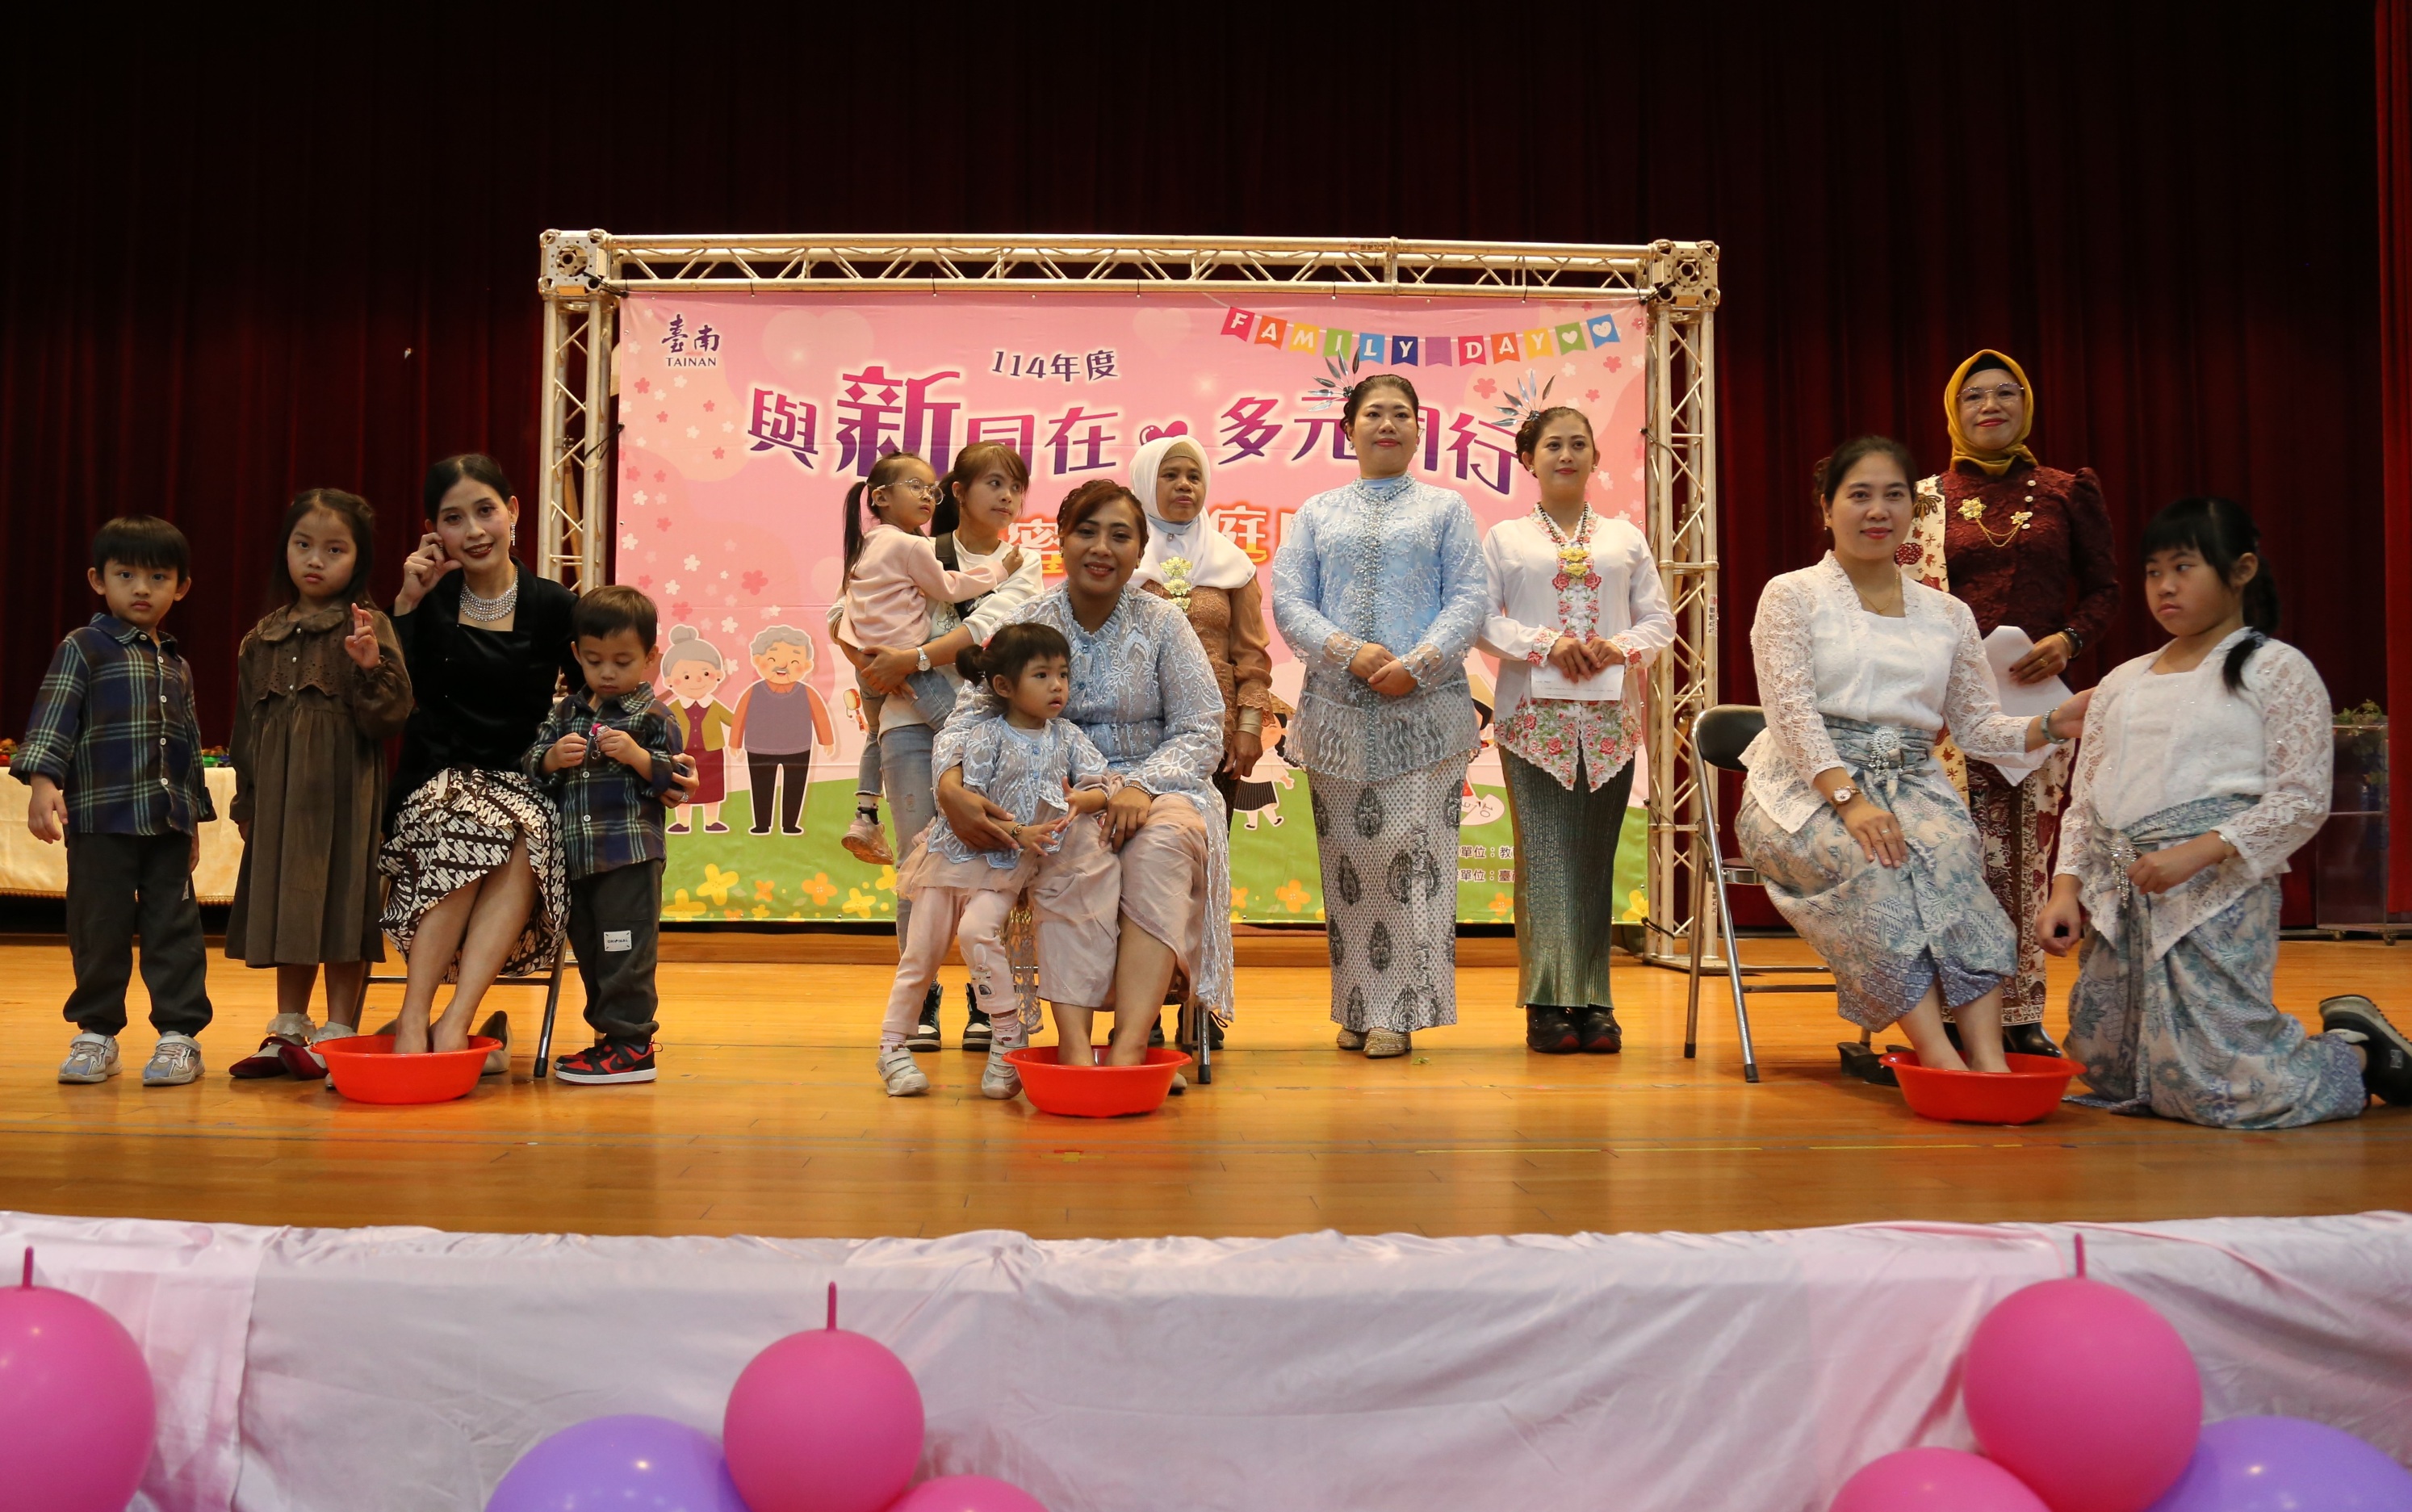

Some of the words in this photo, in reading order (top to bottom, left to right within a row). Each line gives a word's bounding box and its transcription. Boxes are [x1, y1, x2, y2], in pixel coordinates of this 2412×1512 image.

[661, 313, 720, 353] 臺南
[1230, 312, 1413, 358] FAMILY
[1464, 332, 1545, 359] DAY
[665, 357, 717, 367] TAINAN
[991, 350, 1119, 383] 114年度
